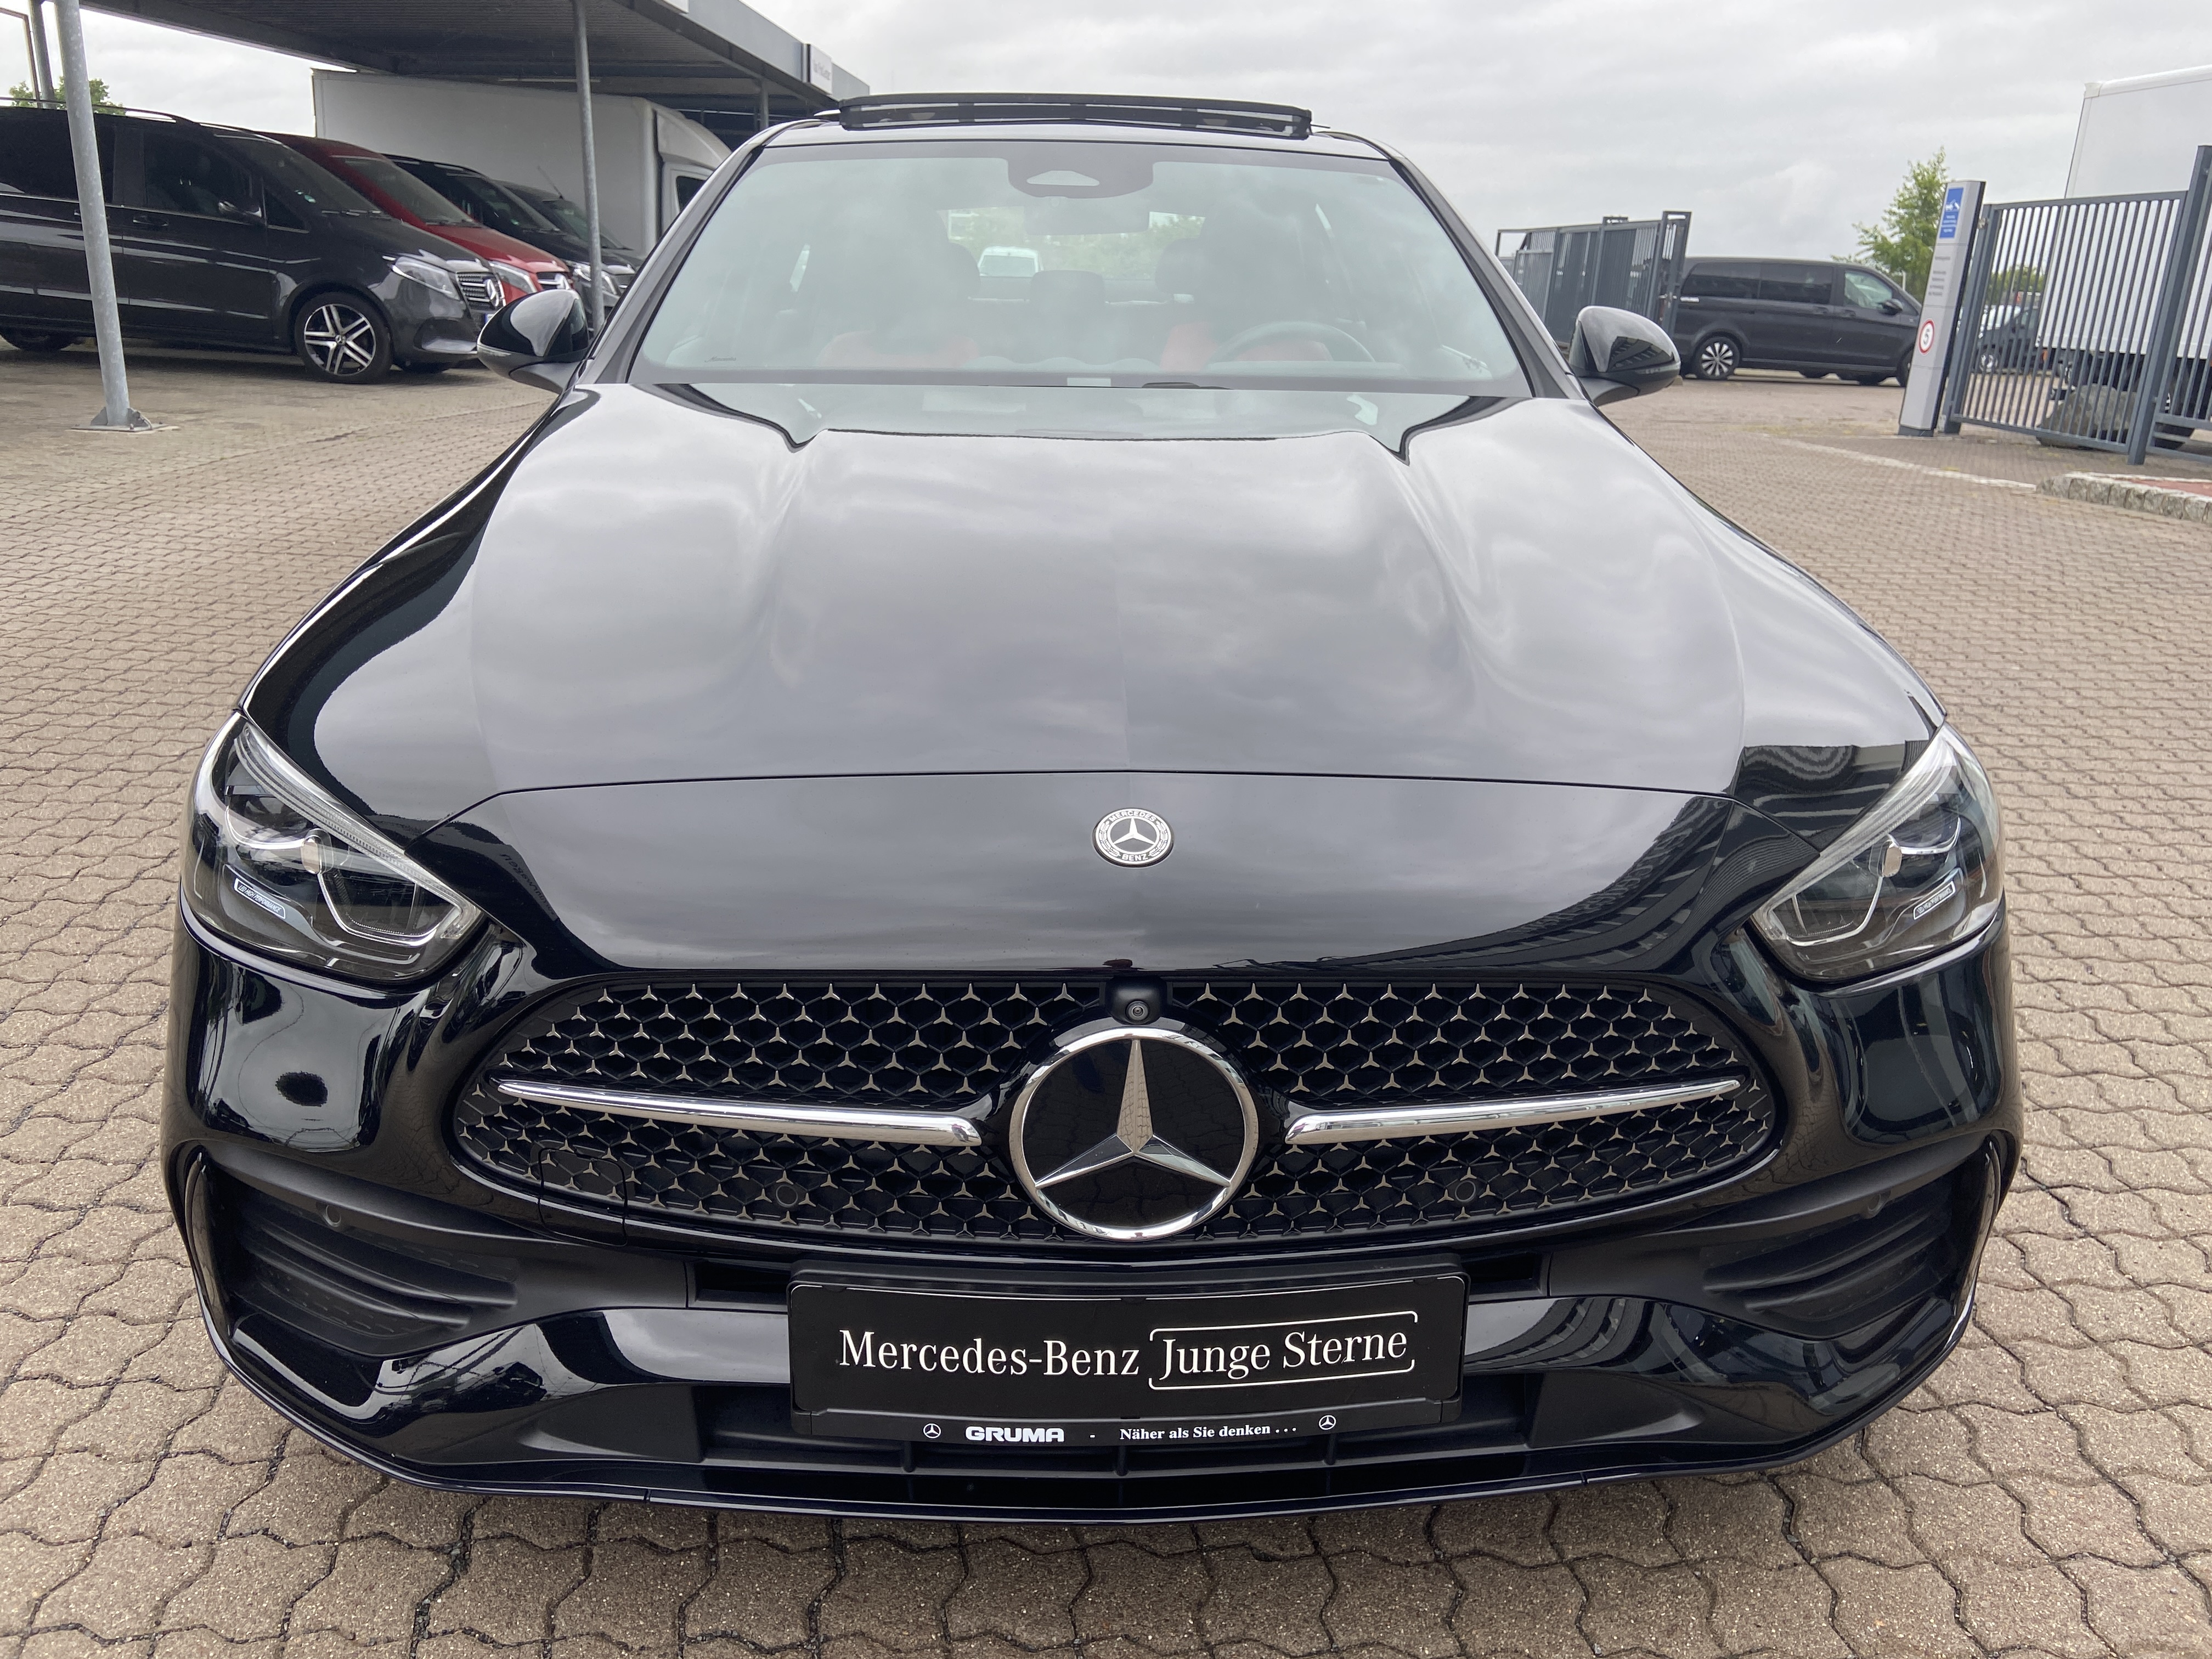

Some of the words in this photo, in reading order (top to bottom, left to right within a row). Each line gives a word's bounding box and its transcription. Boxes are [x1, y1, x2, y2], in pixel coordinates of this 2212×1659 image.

[1923, 328, 1931, 345] 5
[1108, 810, 1156, 822] MERCEDES
[1121, 853, 1149, 861] BENZ
[244, 889, 256, 898] HIGH
[253, 894, 283, 913] PERFORMANCE
[839, 1329, 1139, 1376] Mercedes-Benz
[1159, 1339, 1270, 1380] Junge
[1283, 1331, 1407, 1368] Sterne
[965, 1426, 1065, 1442] GRUMA
[1120, 1428, 1165, 1440] Näher
[1169, 1427, 1189, 1438] als
[1193, 1426, 1215, 1438] Sie
[1218, 1425, 1271, 1437] denken
